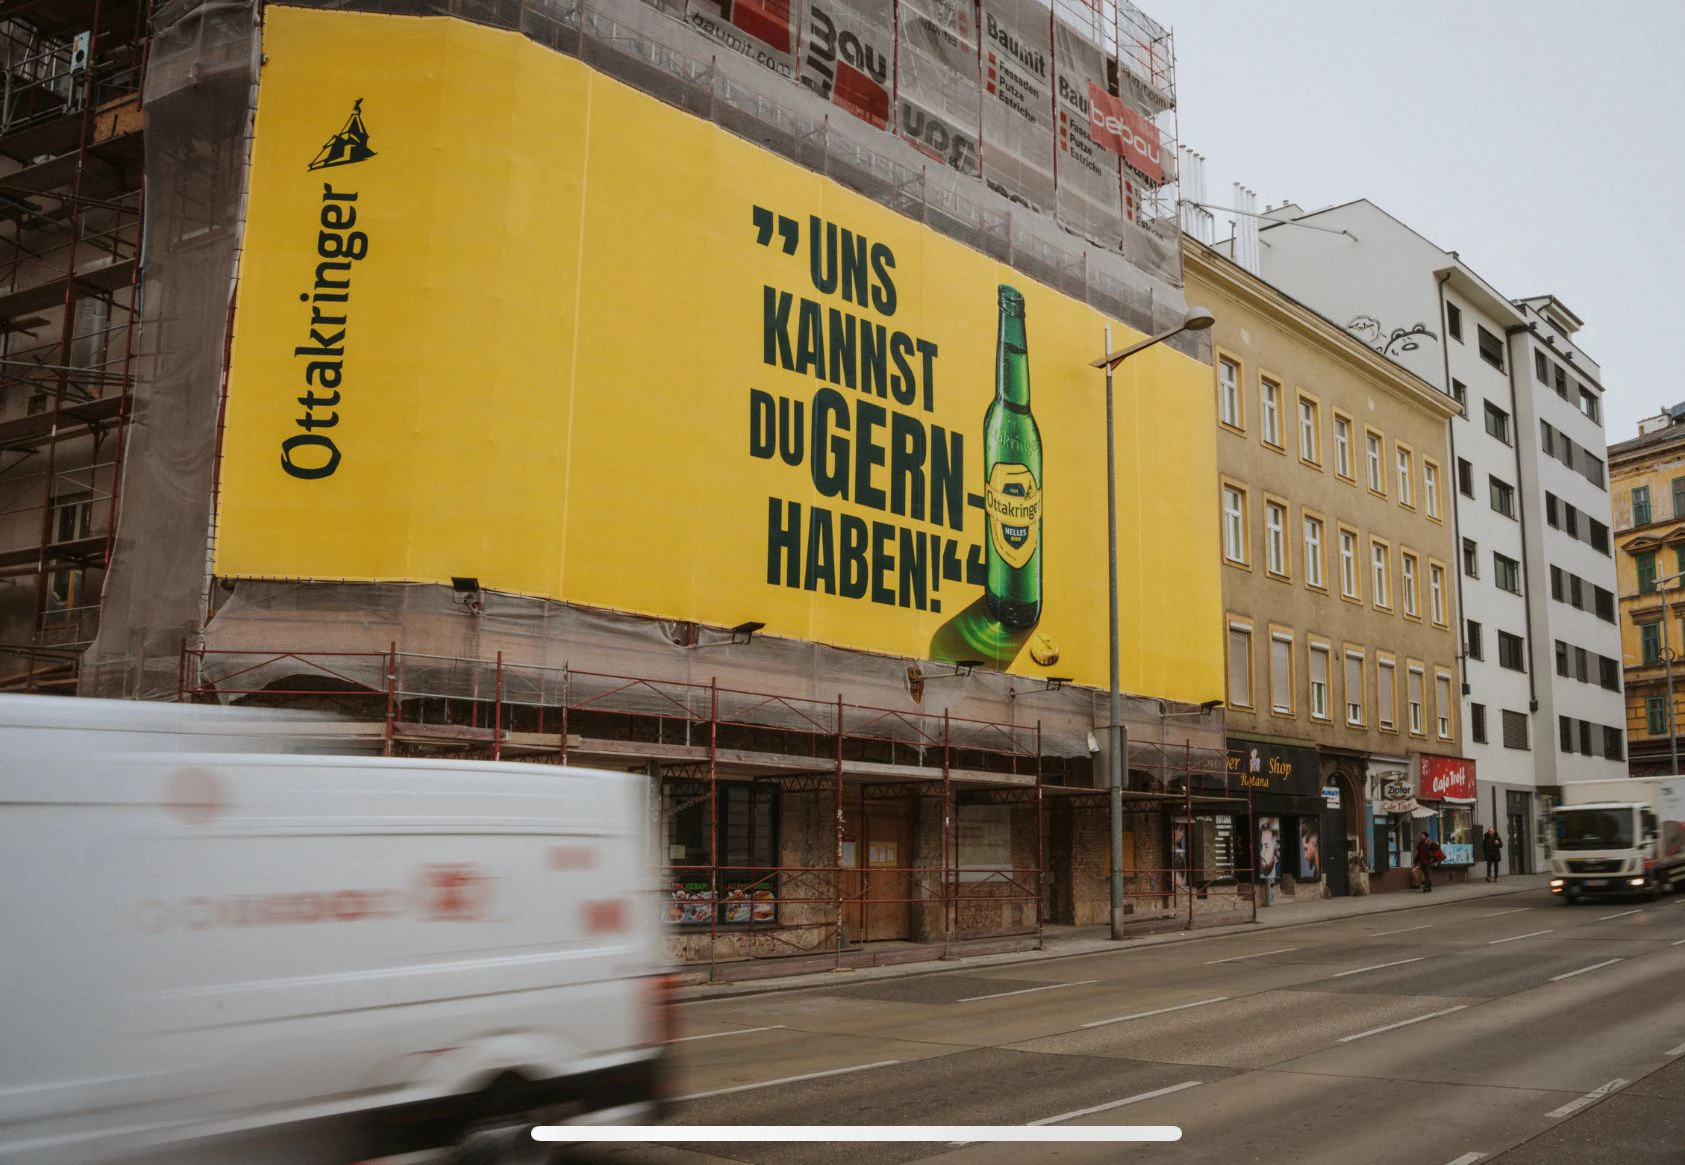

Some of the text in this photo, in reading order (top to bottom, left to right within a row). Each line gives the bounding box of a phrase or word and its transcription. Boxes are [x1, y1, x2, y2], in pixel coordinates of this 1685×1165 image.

[692, 12, 791, 78] baumit.com
[986, 11, 1046, 78] Baumit
[999, 60, 1040, 99] Fassaden
[999, 78, 1025, 101] Putze
[998, 90, 1036, 125] Estriche
[1070, 132, 1093, 157] Putze
[1090, 99, 1160, 164] bebau
[1070, 146, 1102, 177] Estriche
[281, 182, 369, 480] Ottakringer
[764, 284, 938, 413] KANNST
[750, 387, 986, 532] DU GERN-
[1005, 527, 1027, 538] HELLES
[1268, 756, 1292, 780] Shop
[1387, 783, 1411, 795] Zipfer
